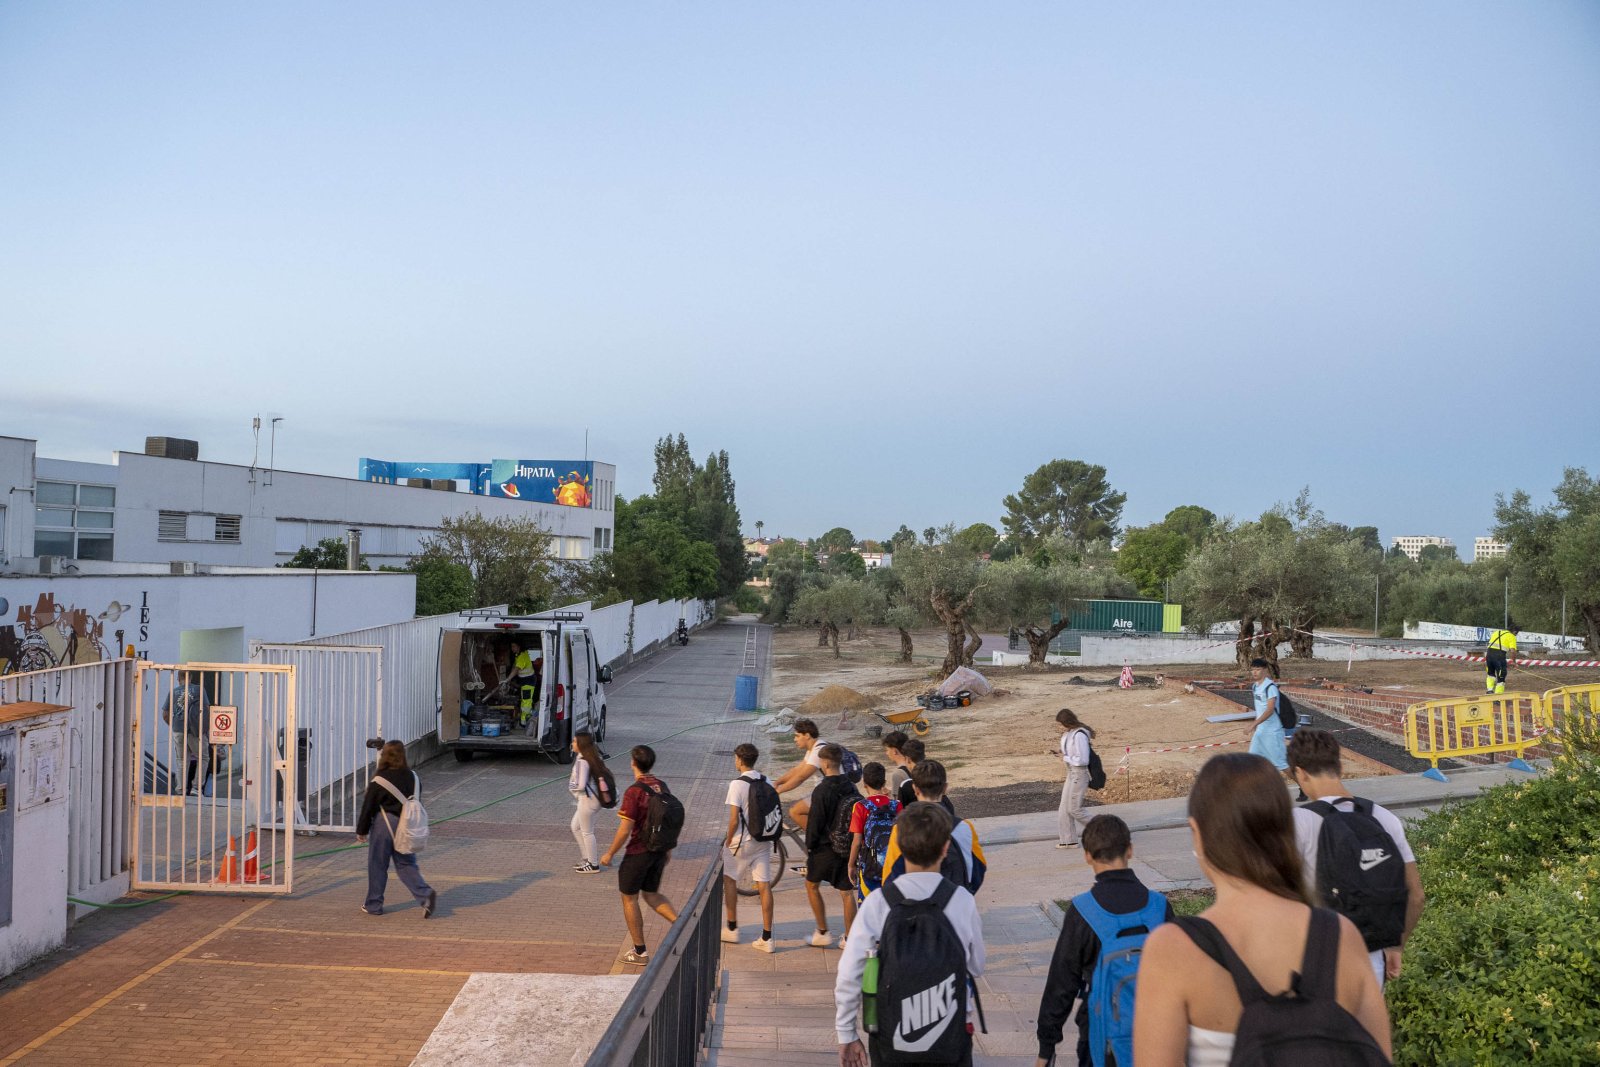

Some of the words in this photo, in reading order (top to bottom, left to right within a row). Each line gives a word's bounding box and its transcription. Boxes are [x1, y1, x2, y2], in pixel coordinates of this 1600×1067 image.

[514, 464, 555, 479] HIPATIA
[140, 591, 150, 642] IES
[1112, 618, 1133, 628] Aire
[764, 804, 780, 830] NIKE
[901, 972, 956, 1036] NIKE
